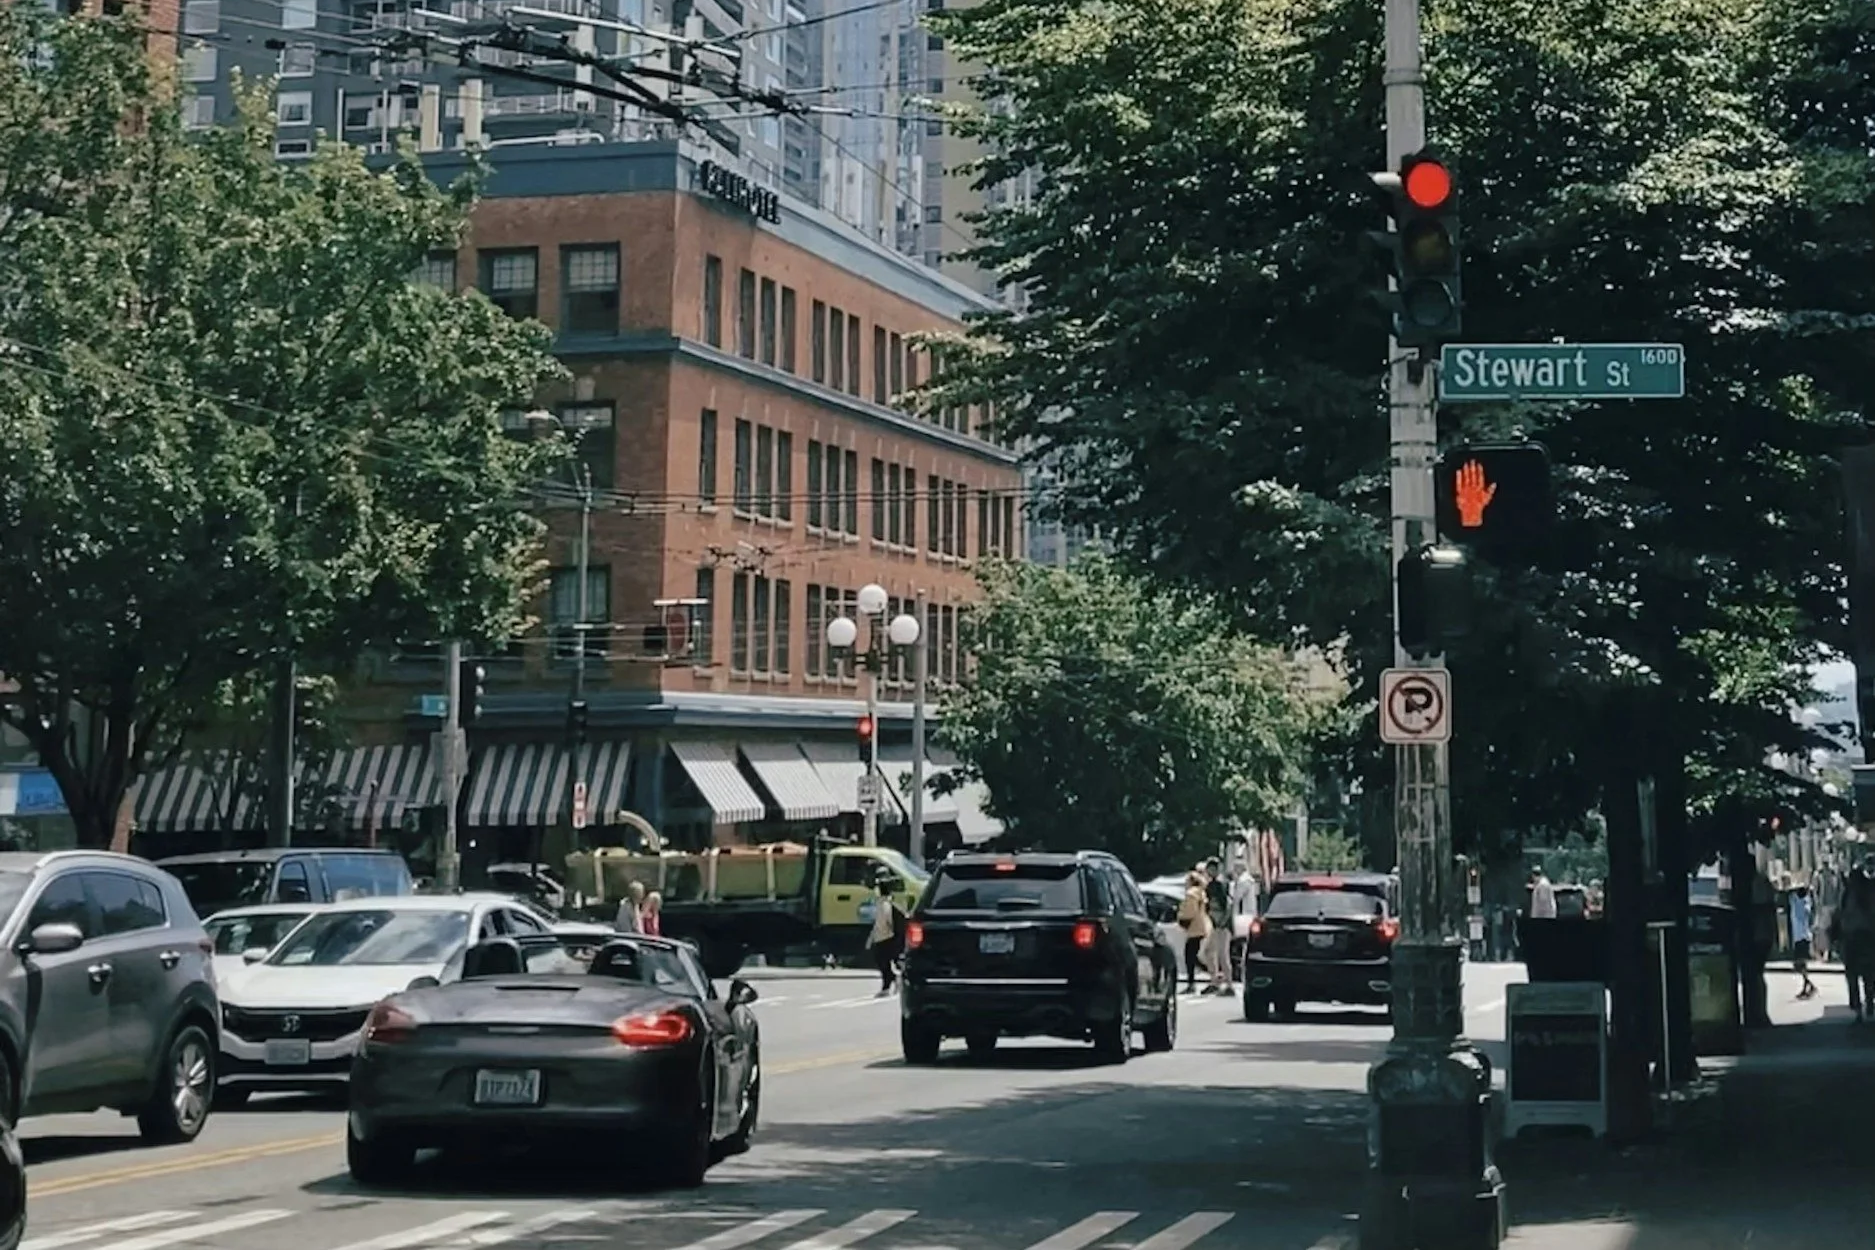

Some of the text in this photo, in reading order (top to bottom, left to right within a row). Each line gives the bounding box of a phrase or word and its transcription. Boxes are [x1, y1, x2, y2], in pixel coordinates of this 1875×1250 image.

[1454, 349, 1631, 387] Stewart St
[1640, 349, 1678, 365] 1600
